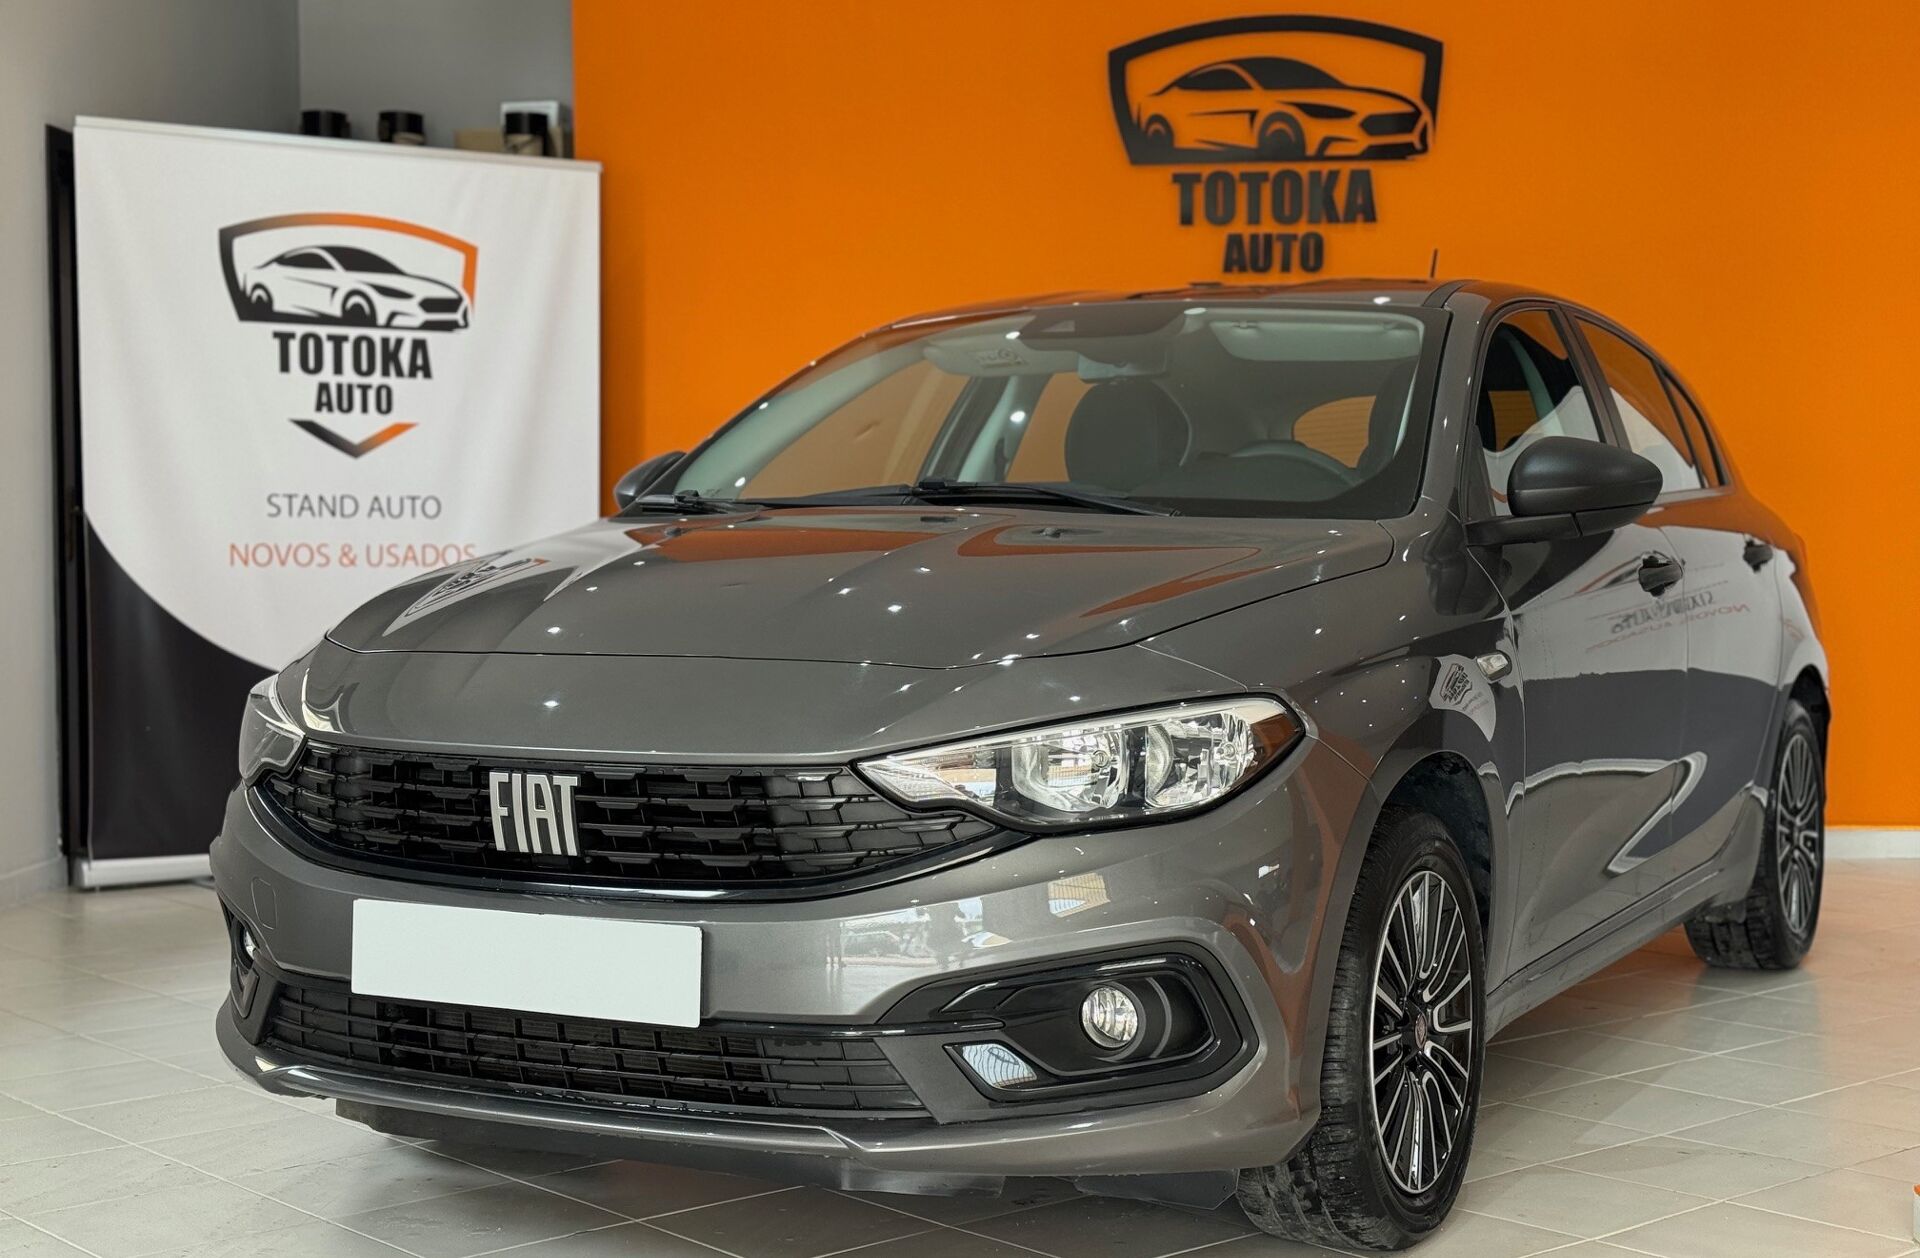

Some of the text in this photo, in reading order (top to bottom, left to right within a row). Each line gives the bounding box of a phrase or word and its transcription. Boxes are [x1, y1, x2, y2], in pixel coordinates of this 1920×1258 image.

[1172, 168, 1377, 226] TOTOKA
[1223, 231, 1324, 273] AUTO
[273, 331, 433, 379] TOTOKA
[315, 381, 394, 415] AUTO
[266, 493, 442, 520] STAND AUTO
[229, 541, 331, 567] NOVOS
[339, 542, 358, 567] &
[489, 772, 579, 857] FIAT
